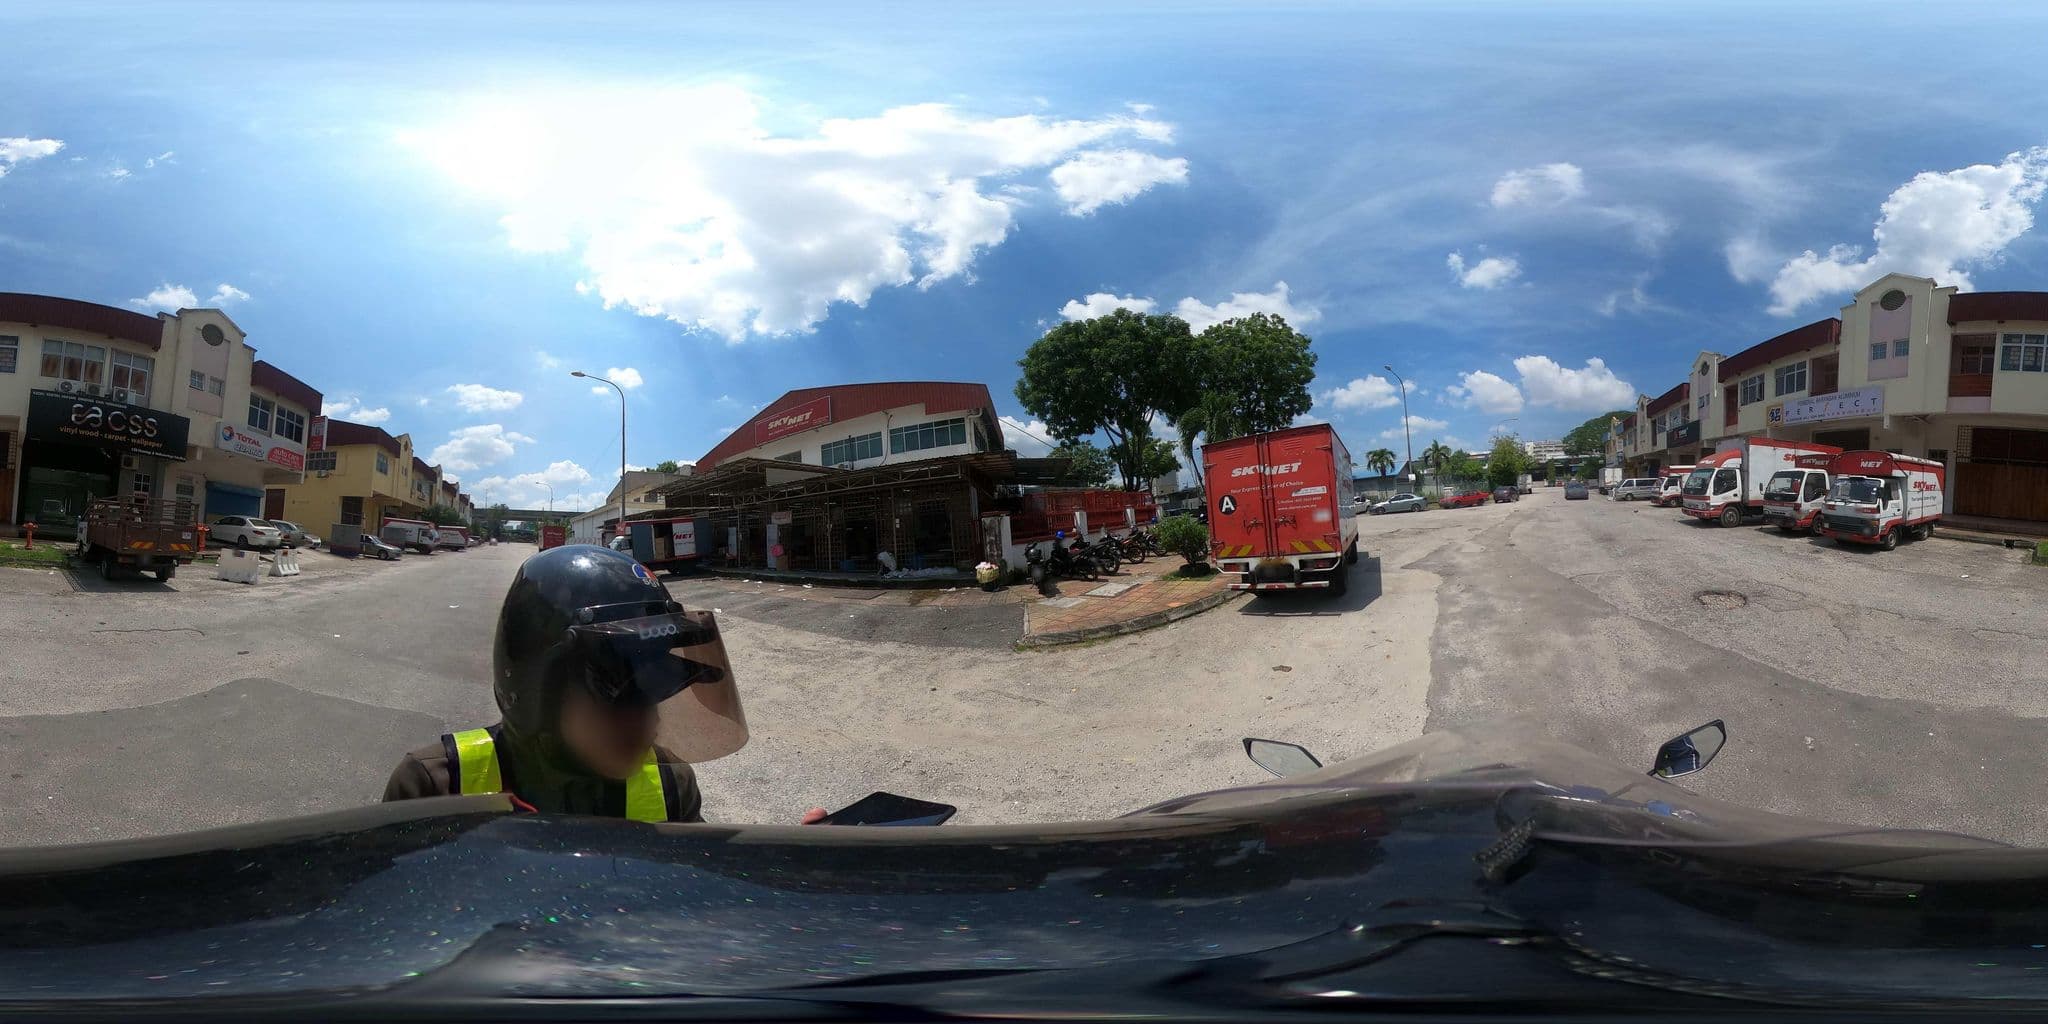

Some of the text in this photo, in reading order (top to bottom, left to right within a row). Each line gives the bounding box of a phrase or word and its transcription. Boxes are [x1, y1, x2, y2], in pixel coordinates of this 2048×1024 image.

[107, 411, 158, 438] CSS
[768, 411, 813, 429] SKYNET
[59, 426, 78, 435] vinyl
[79, 429, 99, 437] wood
[104, 433, 127, 443] carpet
[131, 437, 163, 448] wallpaper
[235, 432, 261, 447] TOTAL
[1231, 462, 1301, 477] SKYNET
[1913, 480, 1937, 492] SKYNET
[1221, 496, 1235, 512] A
